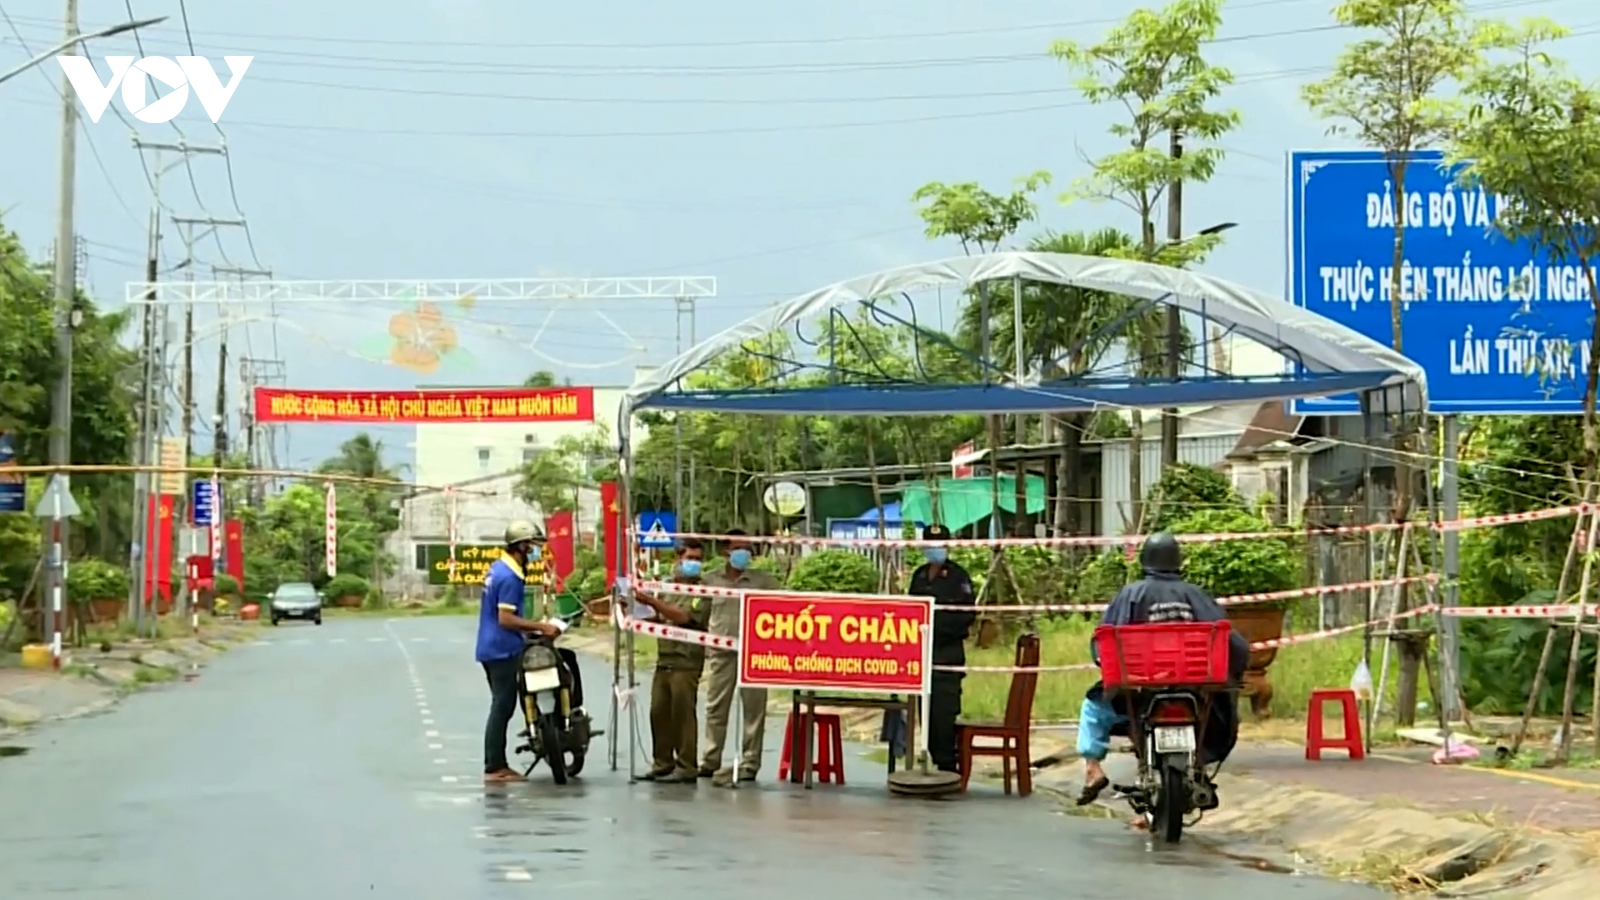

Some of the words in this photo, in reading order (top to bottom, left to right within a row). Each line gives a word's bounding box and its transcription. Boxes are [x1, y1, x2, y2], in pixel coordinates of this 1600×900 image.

[1367, 179, 1423, 228] ĐẢNG
[1429, 183, 1457, 237] BỘ
[1462, 184, 1490, 227] VÀ
[1320, 259, 1375, 311] THỰC
[1379, 259, 1428, 311] HỆN
[1433, 250, 1503, 302] THẮNG
[1450, 324, 1489, 375] LẦN
[304, 394, 335, 420] CỘNG
[381, 395, 399, 420] HỘI
[402, 392, 425, 417] CHỦ
[464, 394, 490, 421] VIỆT
[492, 398, 516, 416] NAM
[755, 604, 832, 641] CHỐT
[839, 612, 919, 652] CHẶN
[794, 650, 833, 673] CHỐNG
[835, 657, 862, 675] DỊCH
[864, 659, 898, 675] COVID
[906, 661, 919, 675] 19
